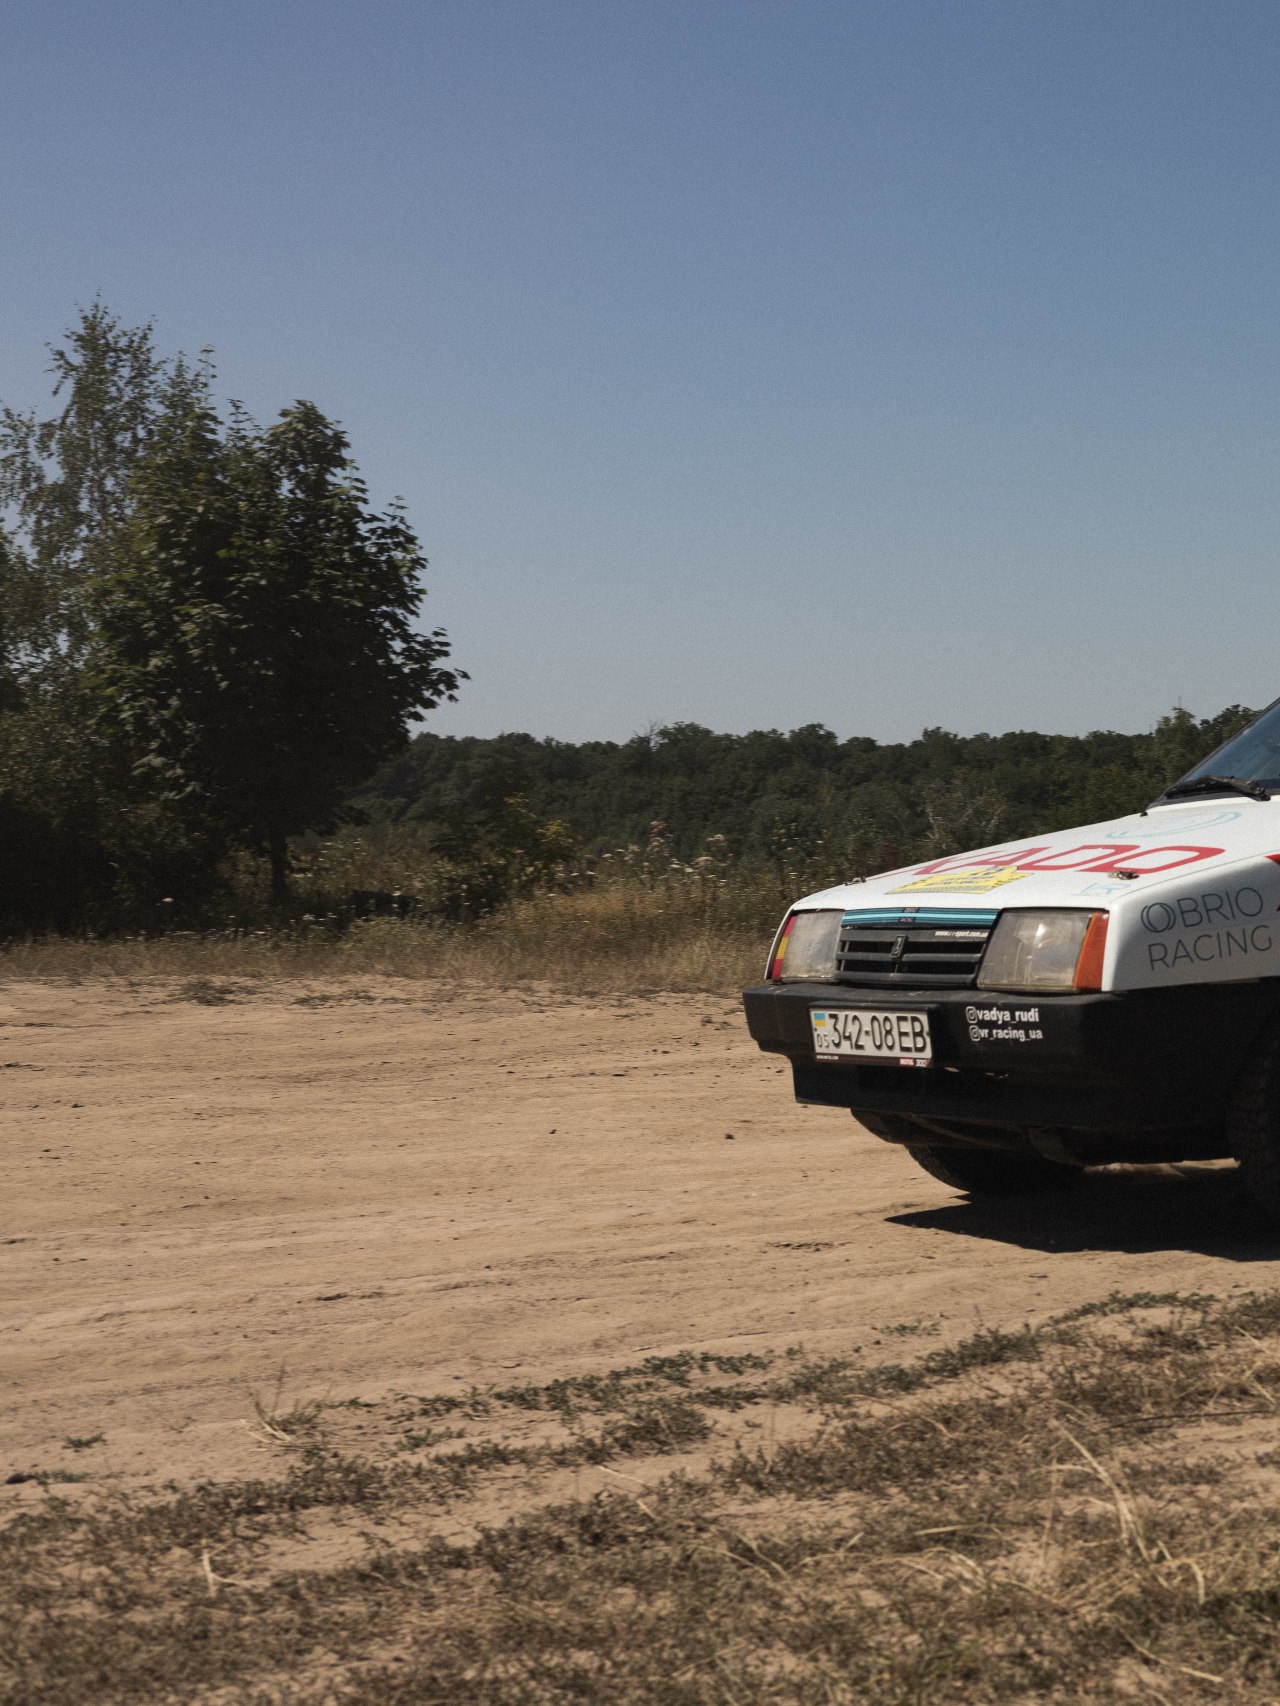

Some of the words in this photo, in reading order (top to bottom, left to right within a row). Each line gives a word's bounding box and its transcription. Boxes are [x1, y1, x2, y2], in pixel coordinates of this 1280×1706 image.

[873, 844, 1226, 881] XADO
[1140, 887, 1264, 933] OBRIO
[1148, 925, 1273, 970] RACING
